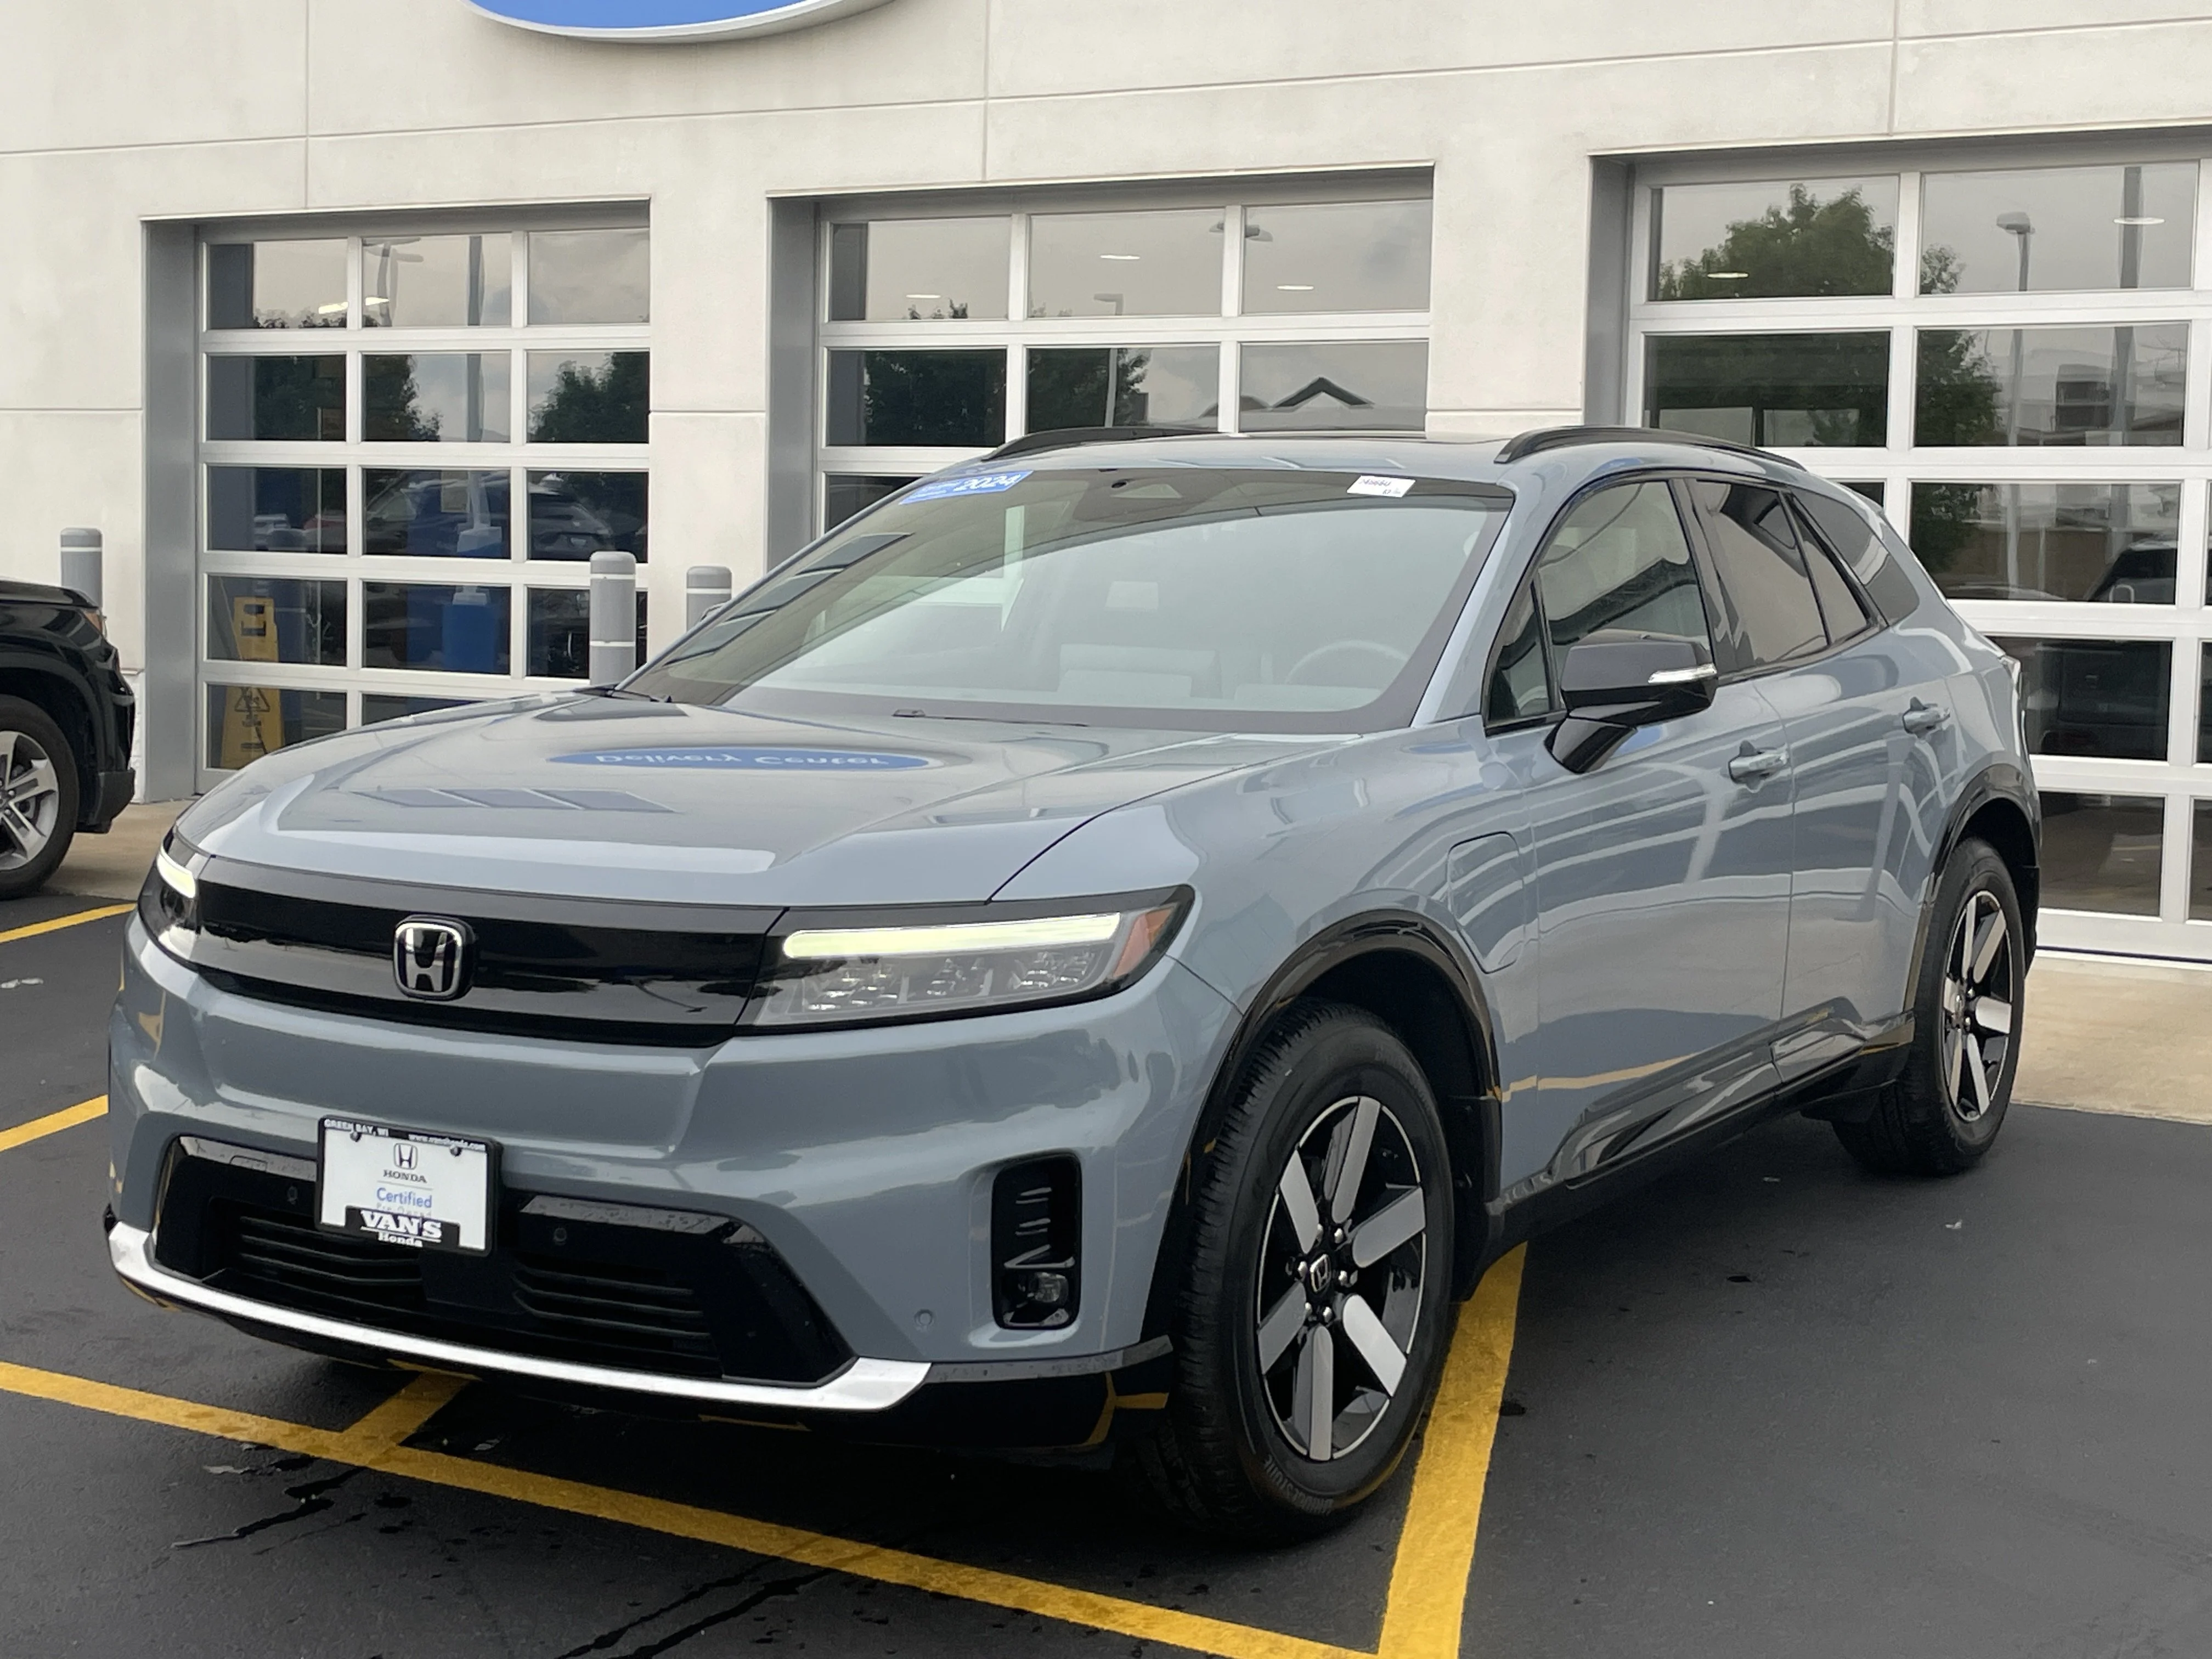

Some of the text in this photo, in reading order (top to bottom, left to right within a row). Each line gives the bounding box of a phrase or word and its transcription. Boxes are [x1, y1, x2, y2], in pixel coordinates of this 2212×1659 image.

[324, 1119, 354, 1131] GREEN
[383, 1169, 428, 1184] HONDA
[376, 1187, 432, 1208] Certified
[360, 1210, 442, 1239] VAN'S
[378, 1232, 423, 1248] Honda
